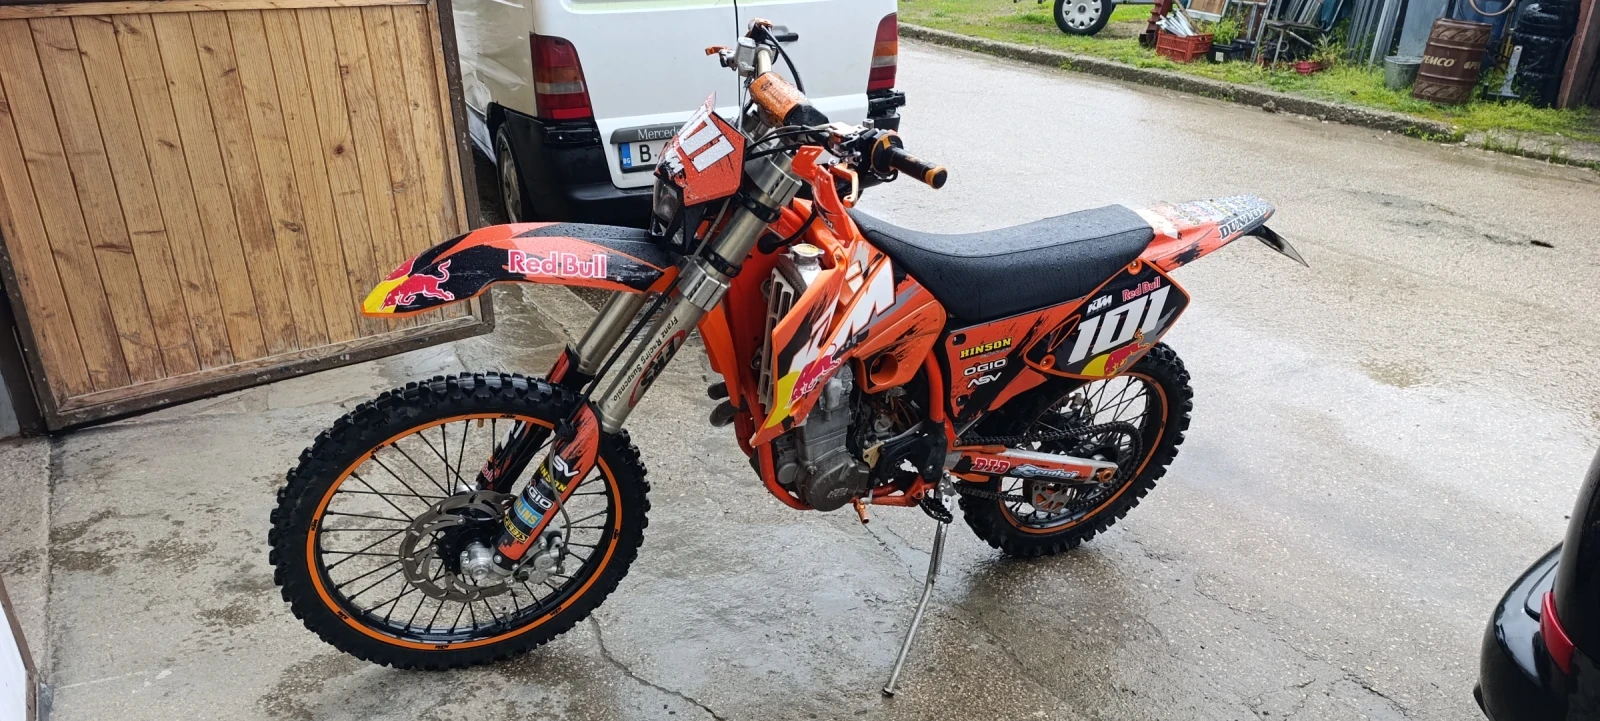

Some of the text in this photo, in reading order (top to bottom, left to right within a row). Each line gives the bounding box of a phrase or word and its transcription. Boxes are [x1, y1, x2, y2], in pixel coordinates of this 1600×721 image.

[638, 126, 681, 141] Mercede
[623, 157, 632, 165] BG
[1219, 206, 1267, 240] DUNLOP
[508, 250, 607, 278] Red Bull
[1122, 276, 1161, 301] Red Bull
[1086, 295, 1113, 315] KTM
[661, 316, 679, 338] Franz
[1067, 285, 1171, 365] 101
[960, 338, 1012, 359] HINSON
[964, 359, 1006, 376] OGIO
[613, 364, 643, 402] Suspensio
[967, 372, 1002, 389] ASV
[553, 455, 579, 477] SV
[540, 463, 568, 492] INSON
[515, 500, 538, 525] HLINS
